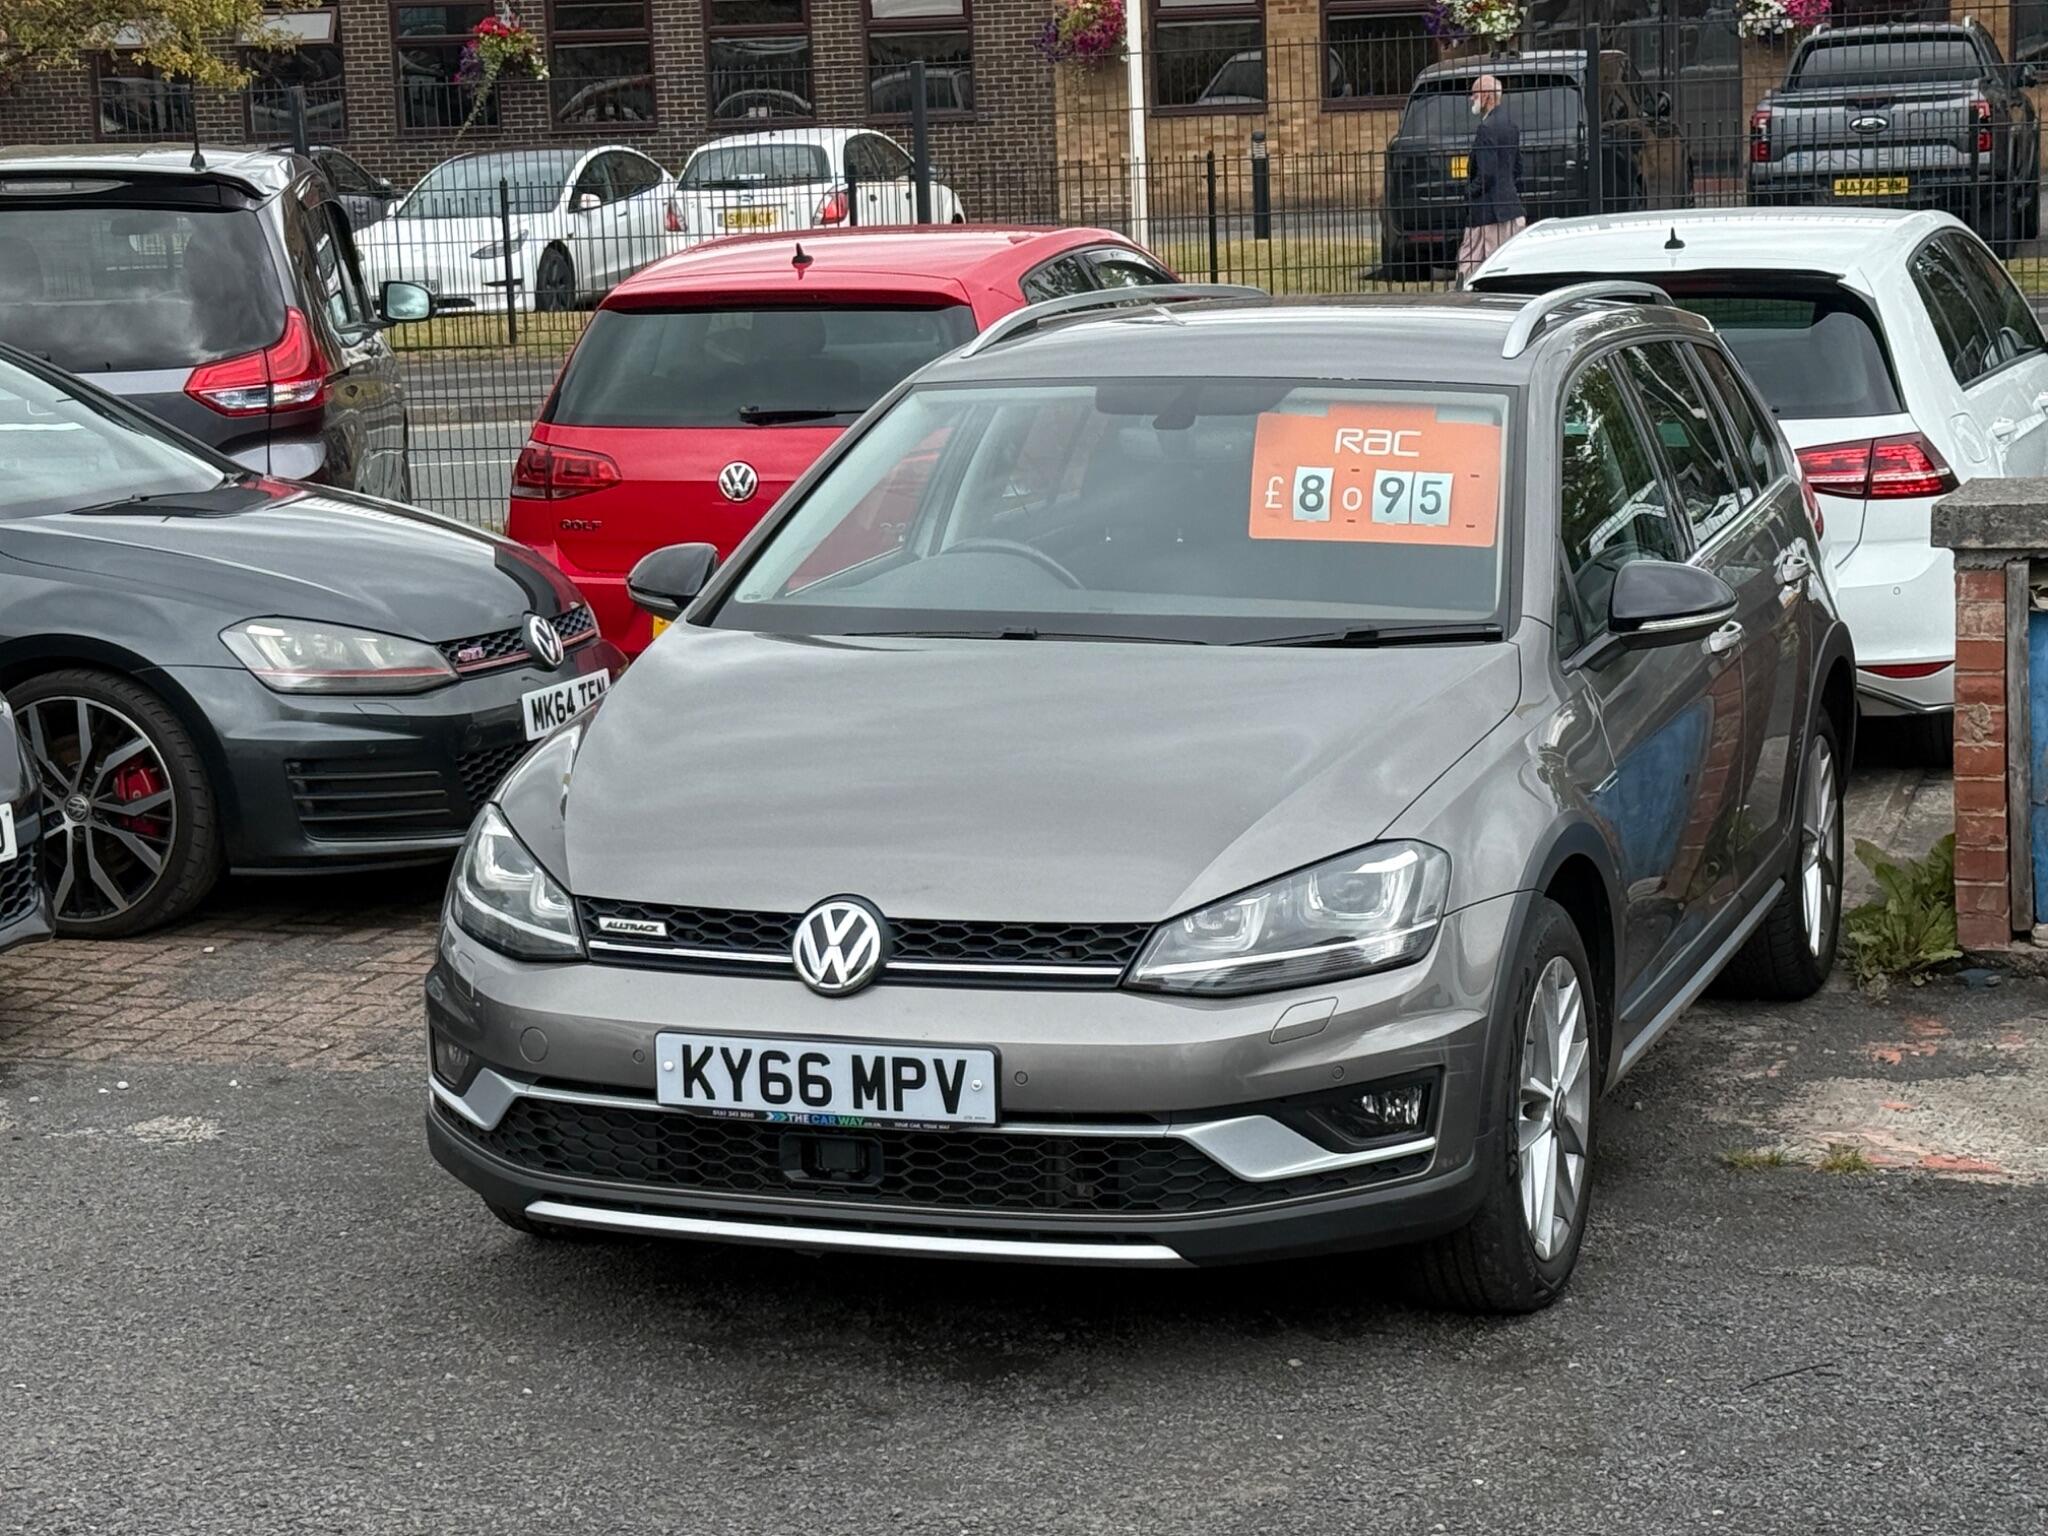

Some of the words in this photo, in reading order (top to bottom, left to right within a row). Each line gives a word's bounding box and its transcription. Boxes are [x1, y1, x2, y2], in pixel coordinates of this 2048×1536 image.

[561, 519, 602, 530] GOLF
[531, 688, 576, 732] MK64
[605, 921, 659, 933] ALLTRACK
[681, 1044, 832, 1106] KY66
[851, 1054, 967, 1114] MPV
